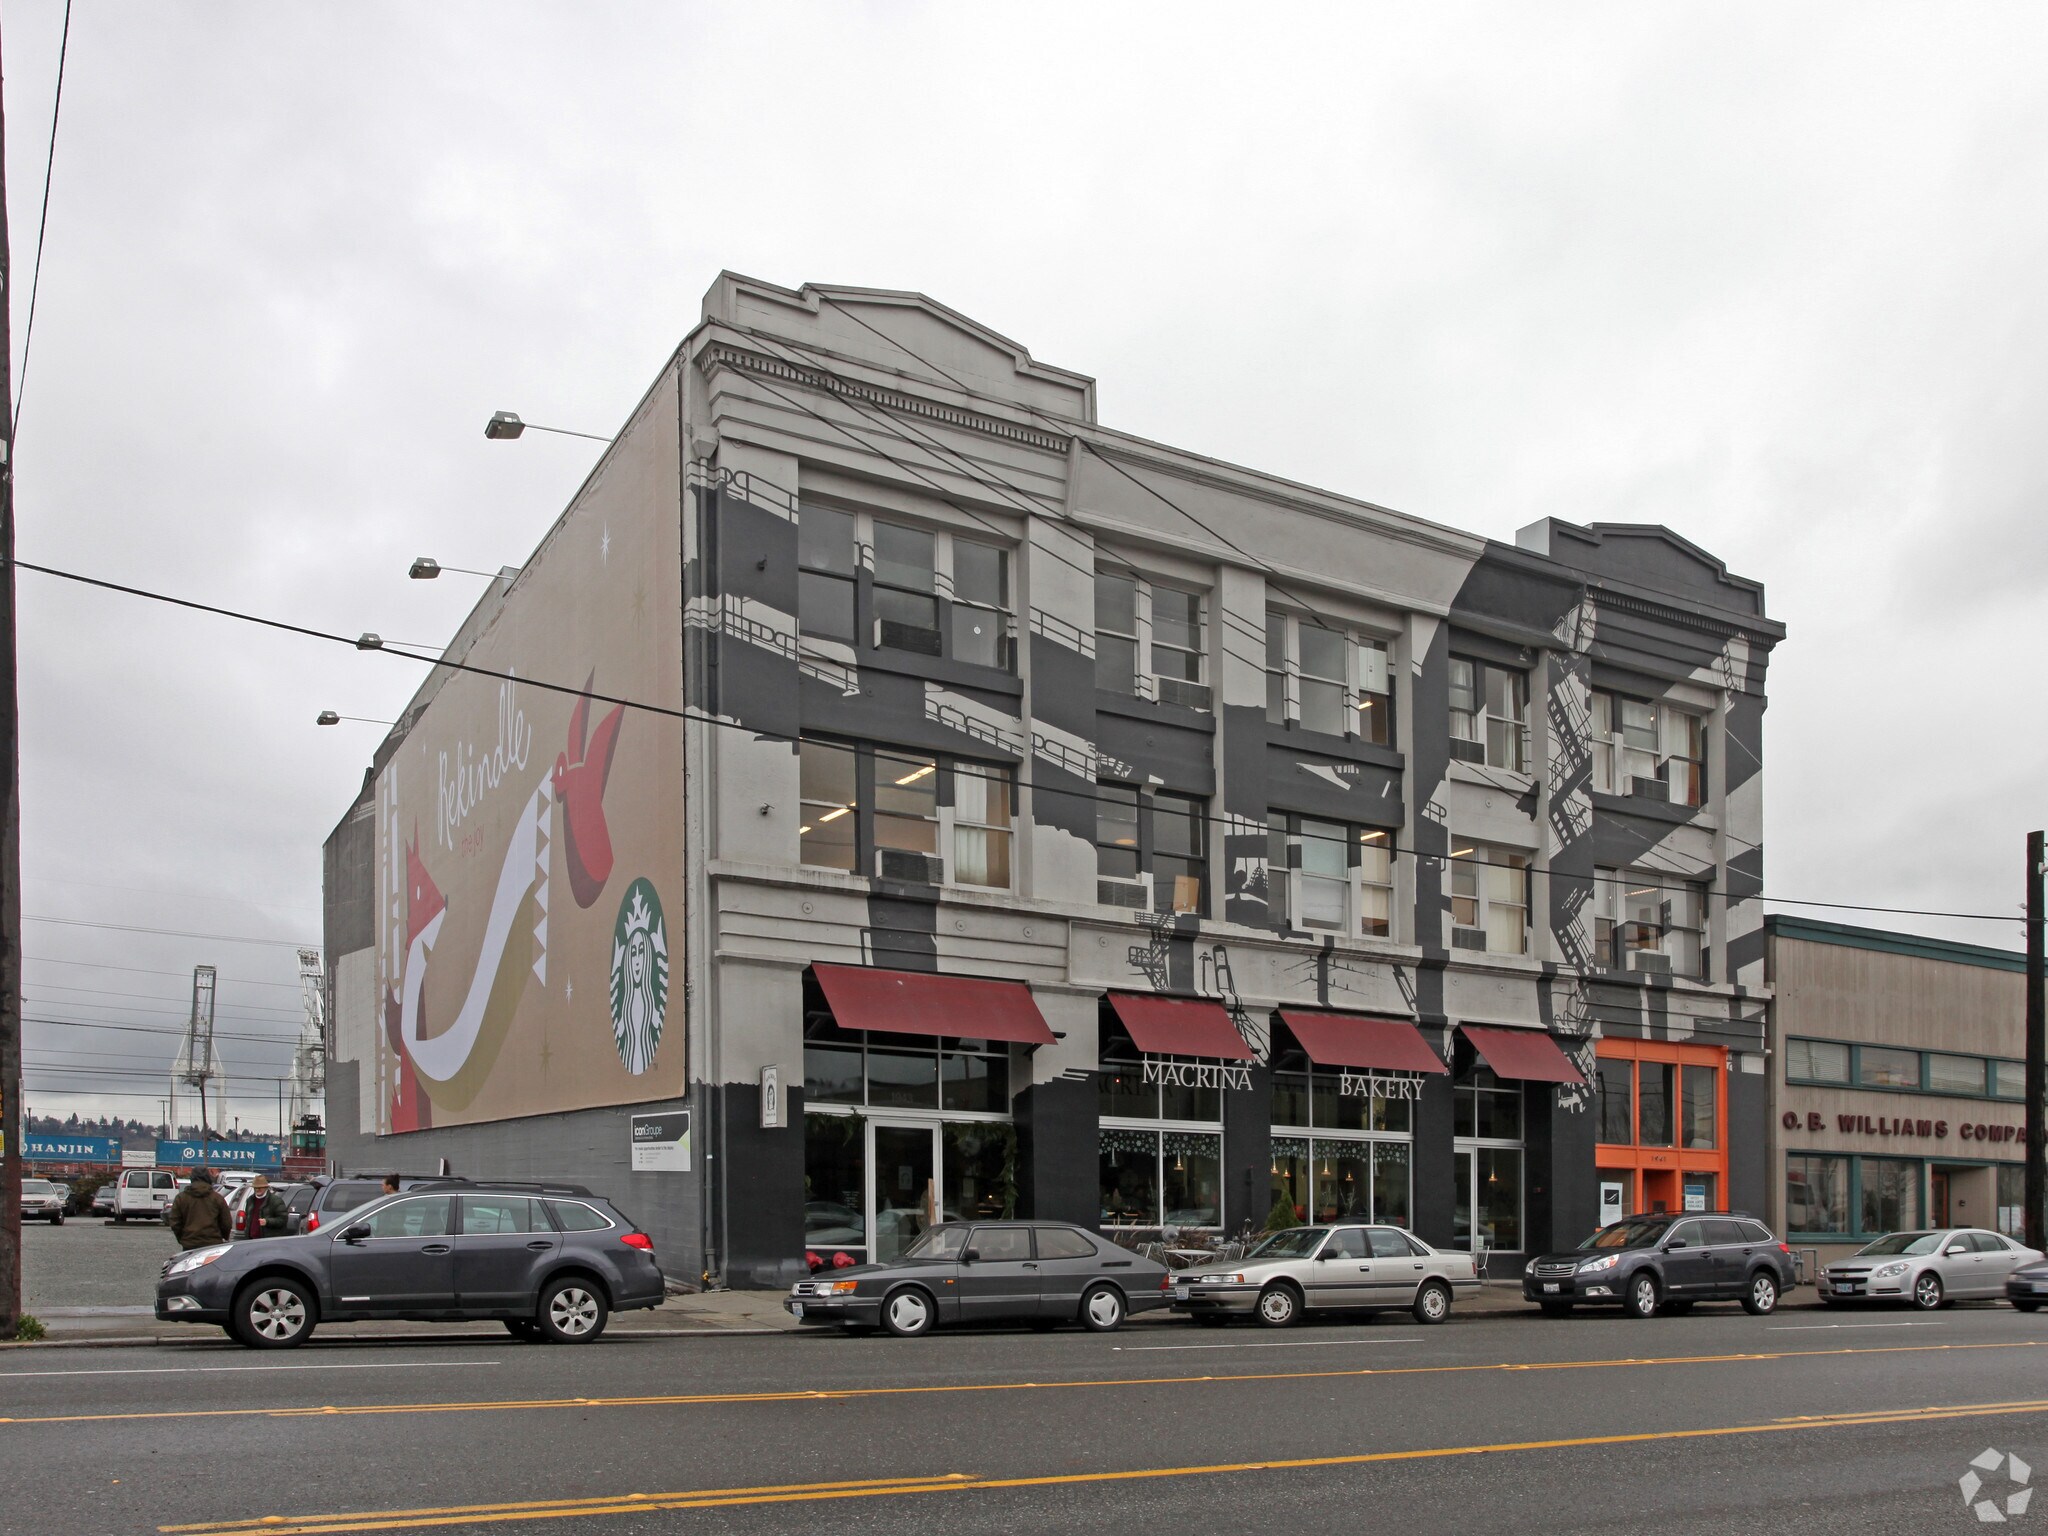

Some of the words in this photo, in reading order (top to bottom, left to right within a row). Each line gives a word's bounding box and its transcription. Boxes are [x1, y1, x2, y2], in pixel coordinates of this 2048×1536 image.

[438, 666, 531, 850] Rekindle
[1142, 1061, 1253, 1091] MACRINA
[1340, 1074, 1425, 1100] BAKERY
[1783, 1111, 1802, 1130] O.
[1808, 1112, 1826, 1131] B.
[1838, 1114, 1948, 1138] WILLIAMS
[1960, 1122, 2048, 1144] COMPA
[31, 1143, 94, 1154] HANJIN
